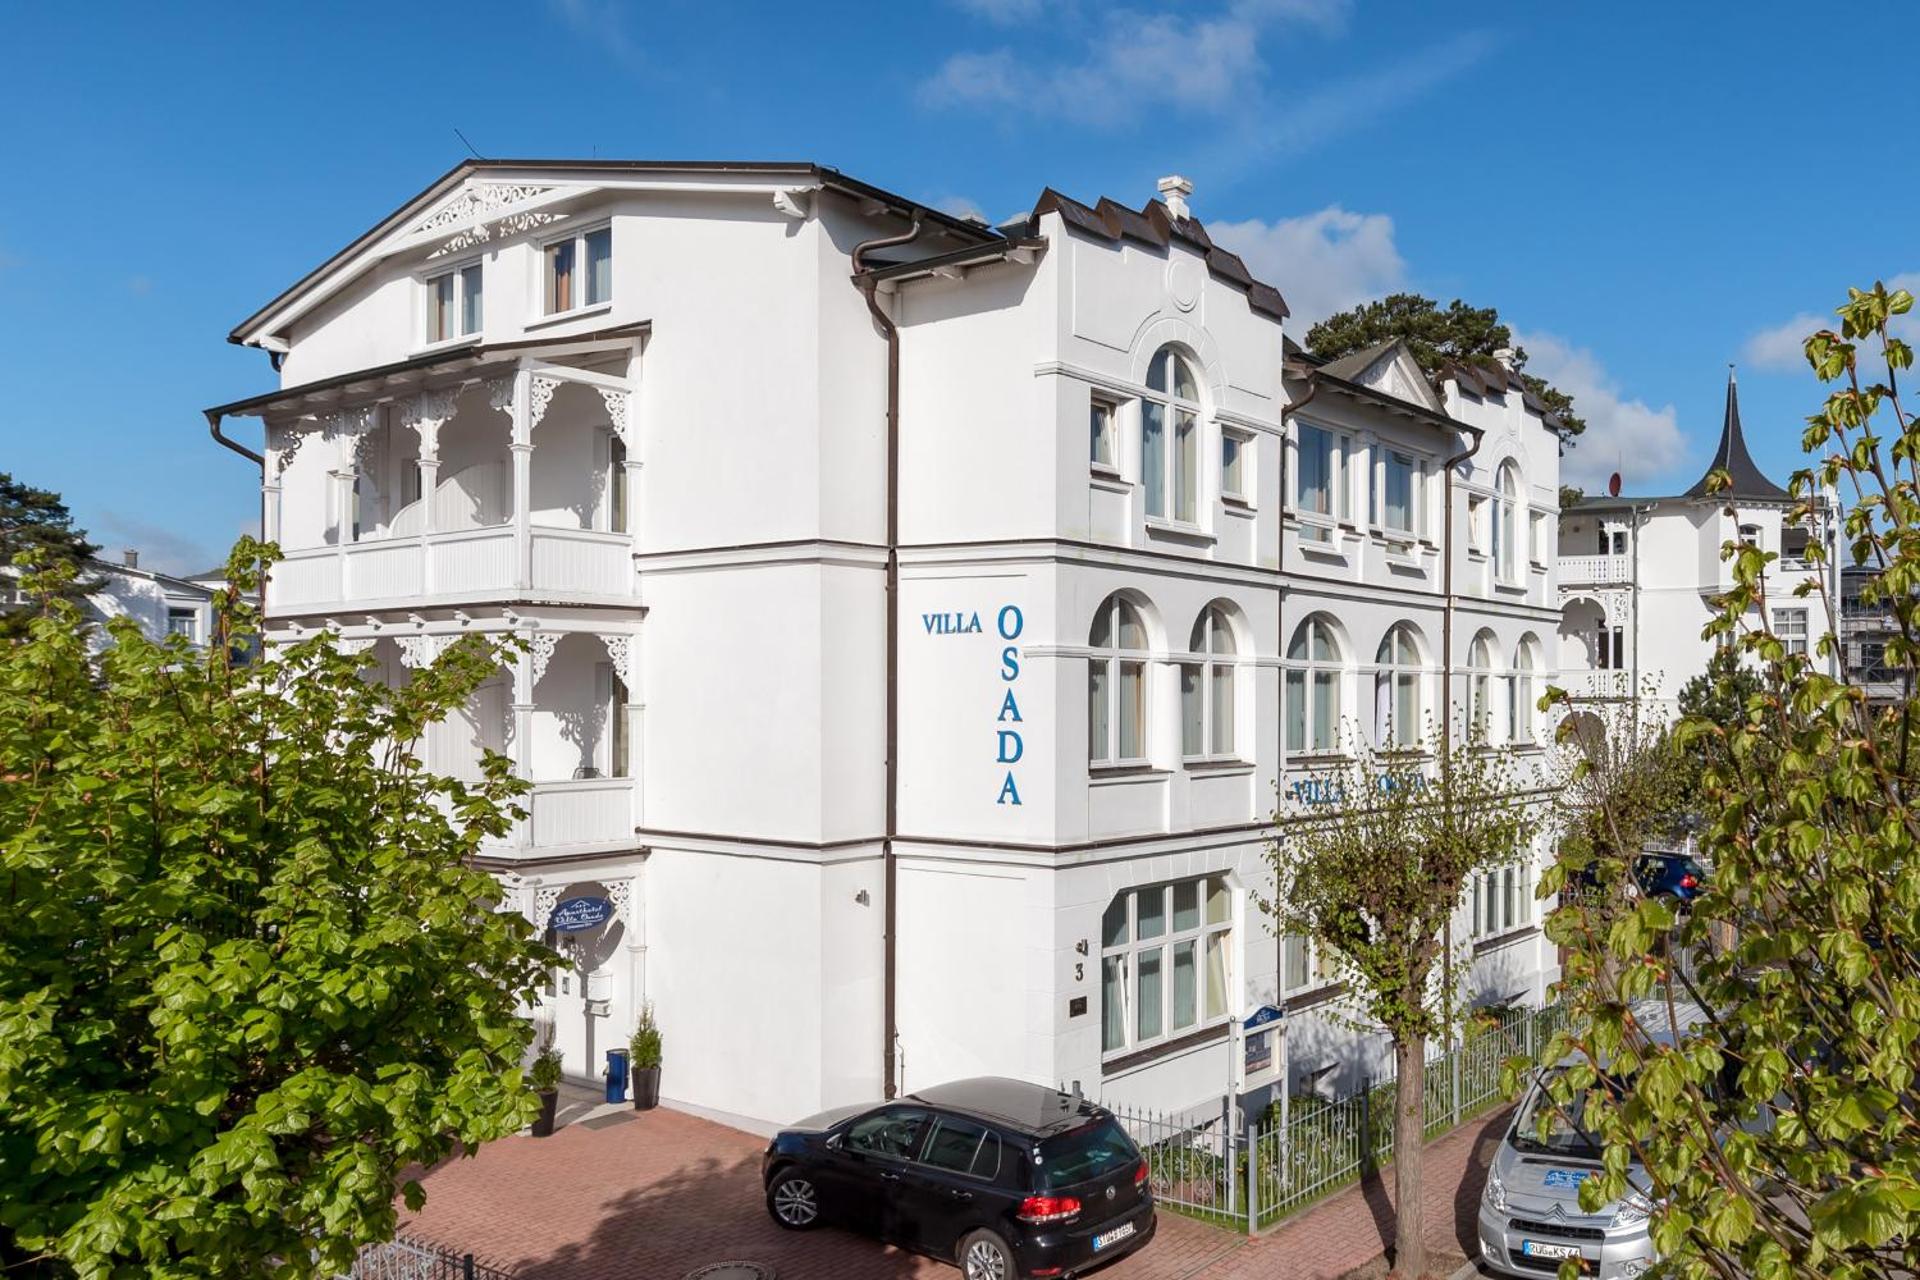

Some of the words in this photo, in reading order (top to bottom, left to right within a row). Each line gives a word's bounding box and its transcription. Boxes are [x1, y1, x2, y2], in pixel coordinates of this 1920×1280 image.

[922, 611, 982, 635] VILLA
[996, 605, 1023, 805] OSADA
[1075, 962, 1084, 982] 3
